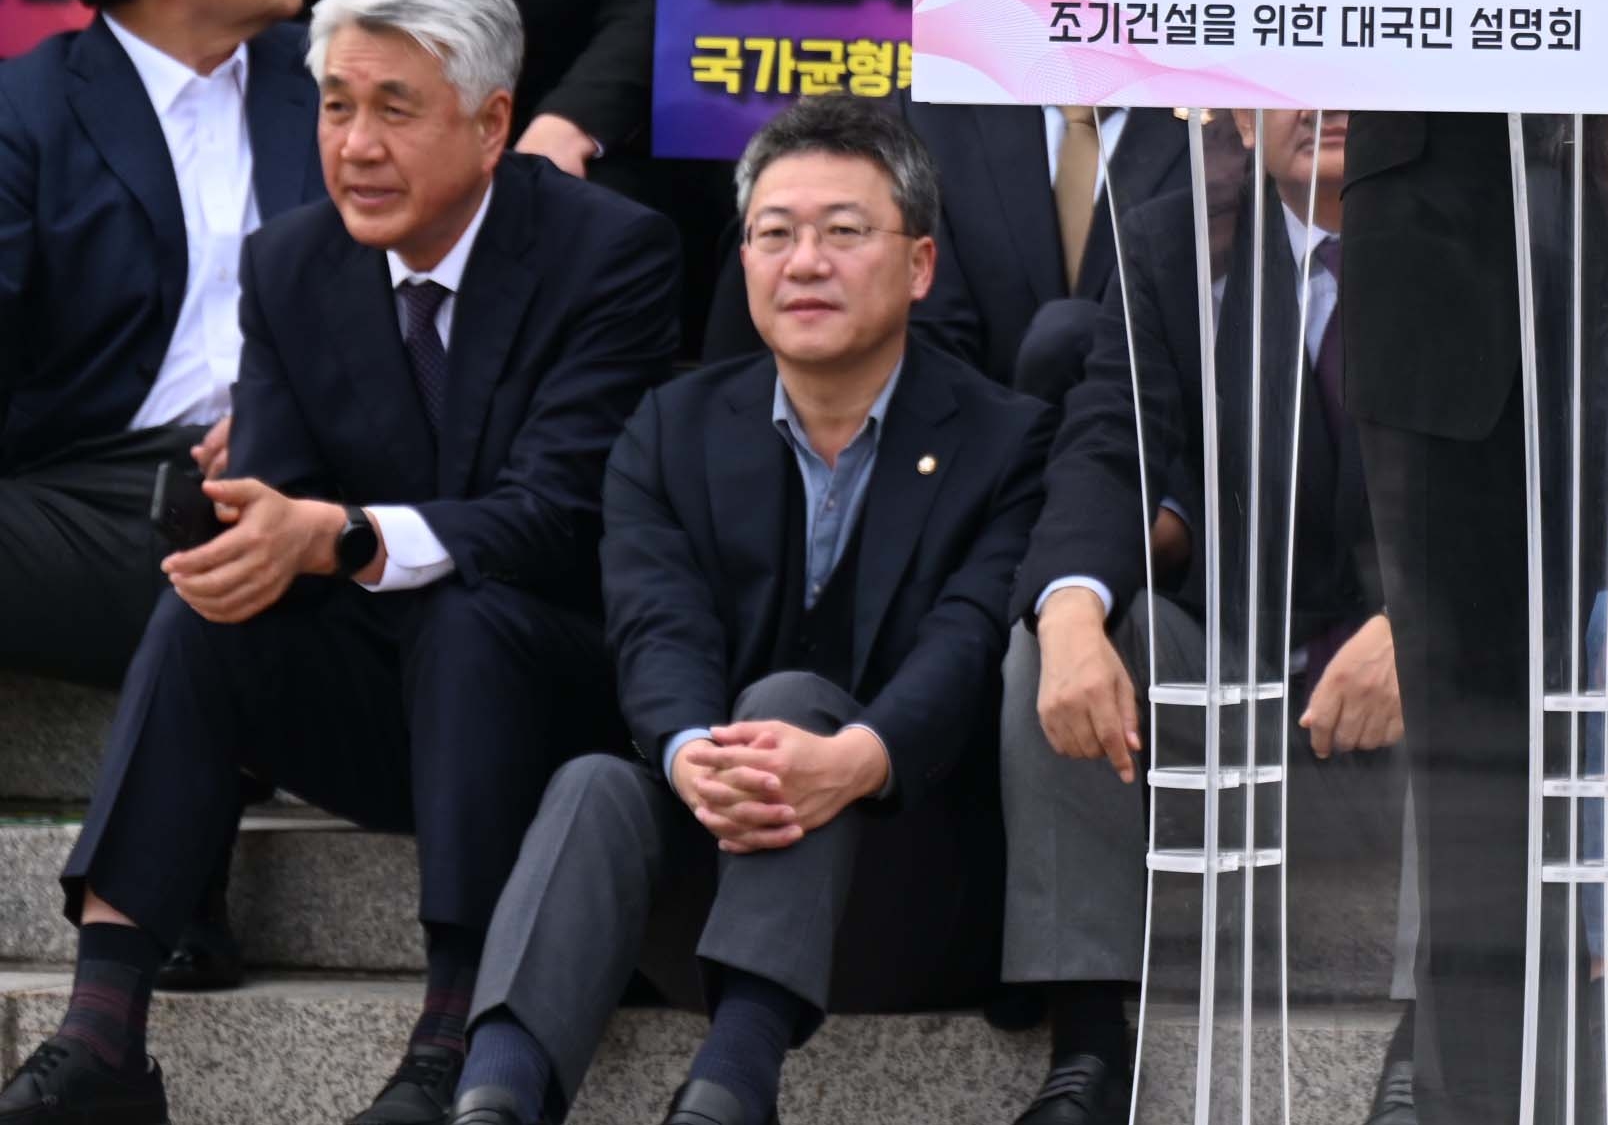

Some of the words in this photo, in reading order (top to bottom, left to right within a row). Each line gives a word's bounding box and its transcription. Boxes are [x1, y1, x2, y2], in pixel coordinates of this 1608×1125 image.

[1049, 1, 1236, 46] 조기건설을
[1252, 3, 1327, 48] 위한
[1341, 5, 1453, 50] 대국민
[1469, 6, 1582, 51] 설명회
